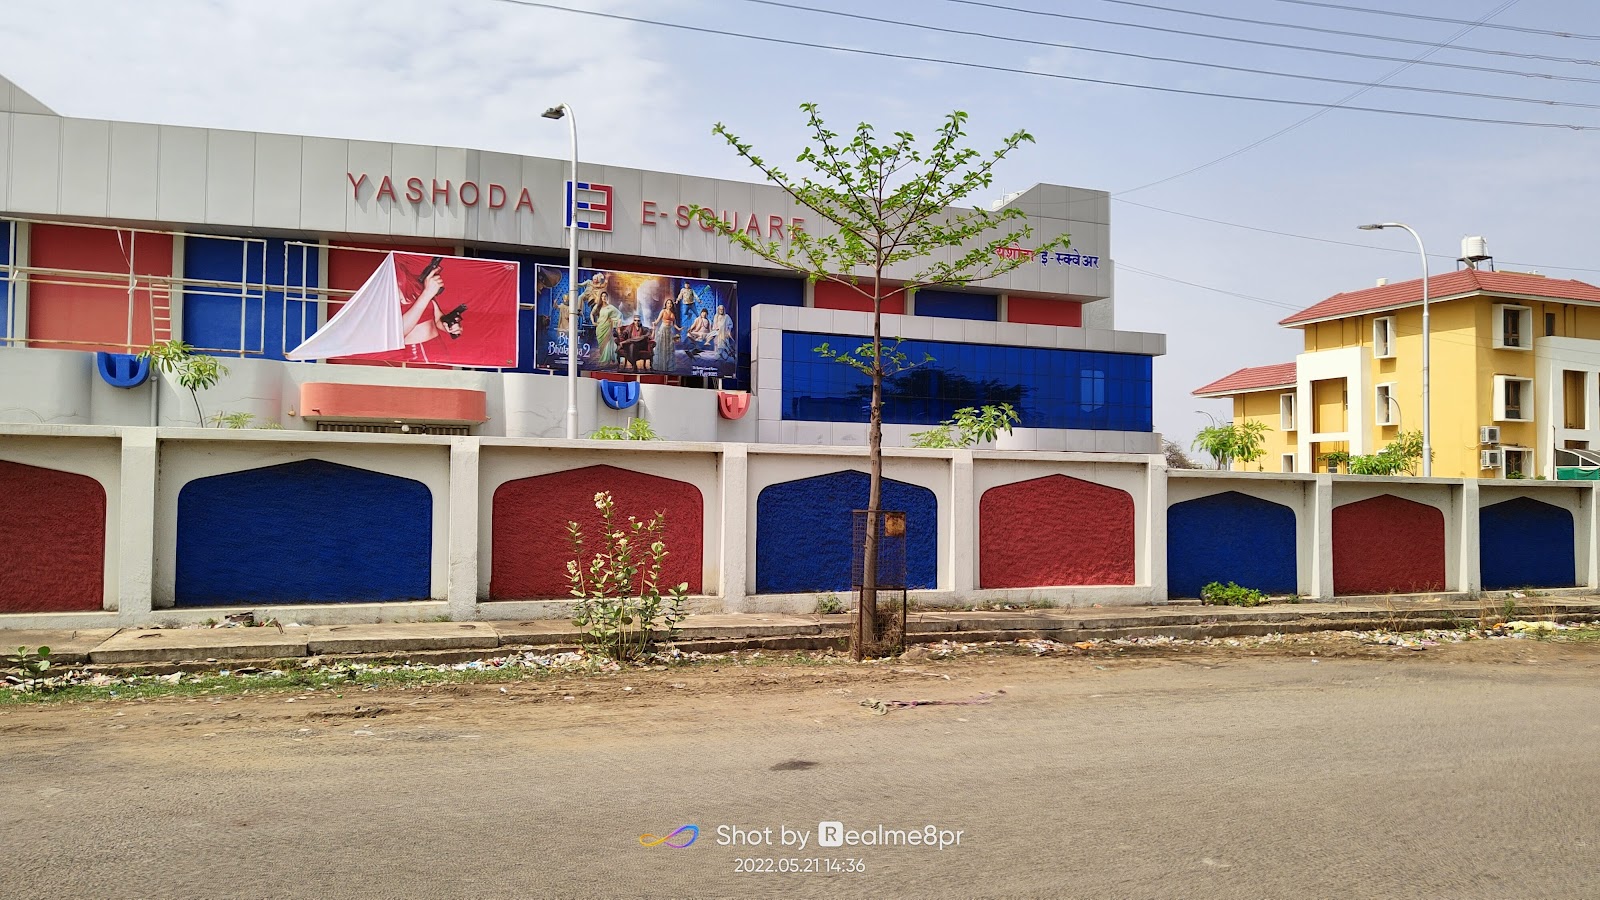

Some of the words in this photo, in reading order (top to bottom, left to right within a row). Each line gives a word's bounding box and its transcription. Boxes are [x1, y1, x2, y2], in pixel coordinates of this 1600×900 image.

[347, 172, 535, 214] YASHODA
[641, 200, 805, 241] E-SQUARE
[558, 331, 582, 346] Bhl
[583, 343, 591, 358] 2
